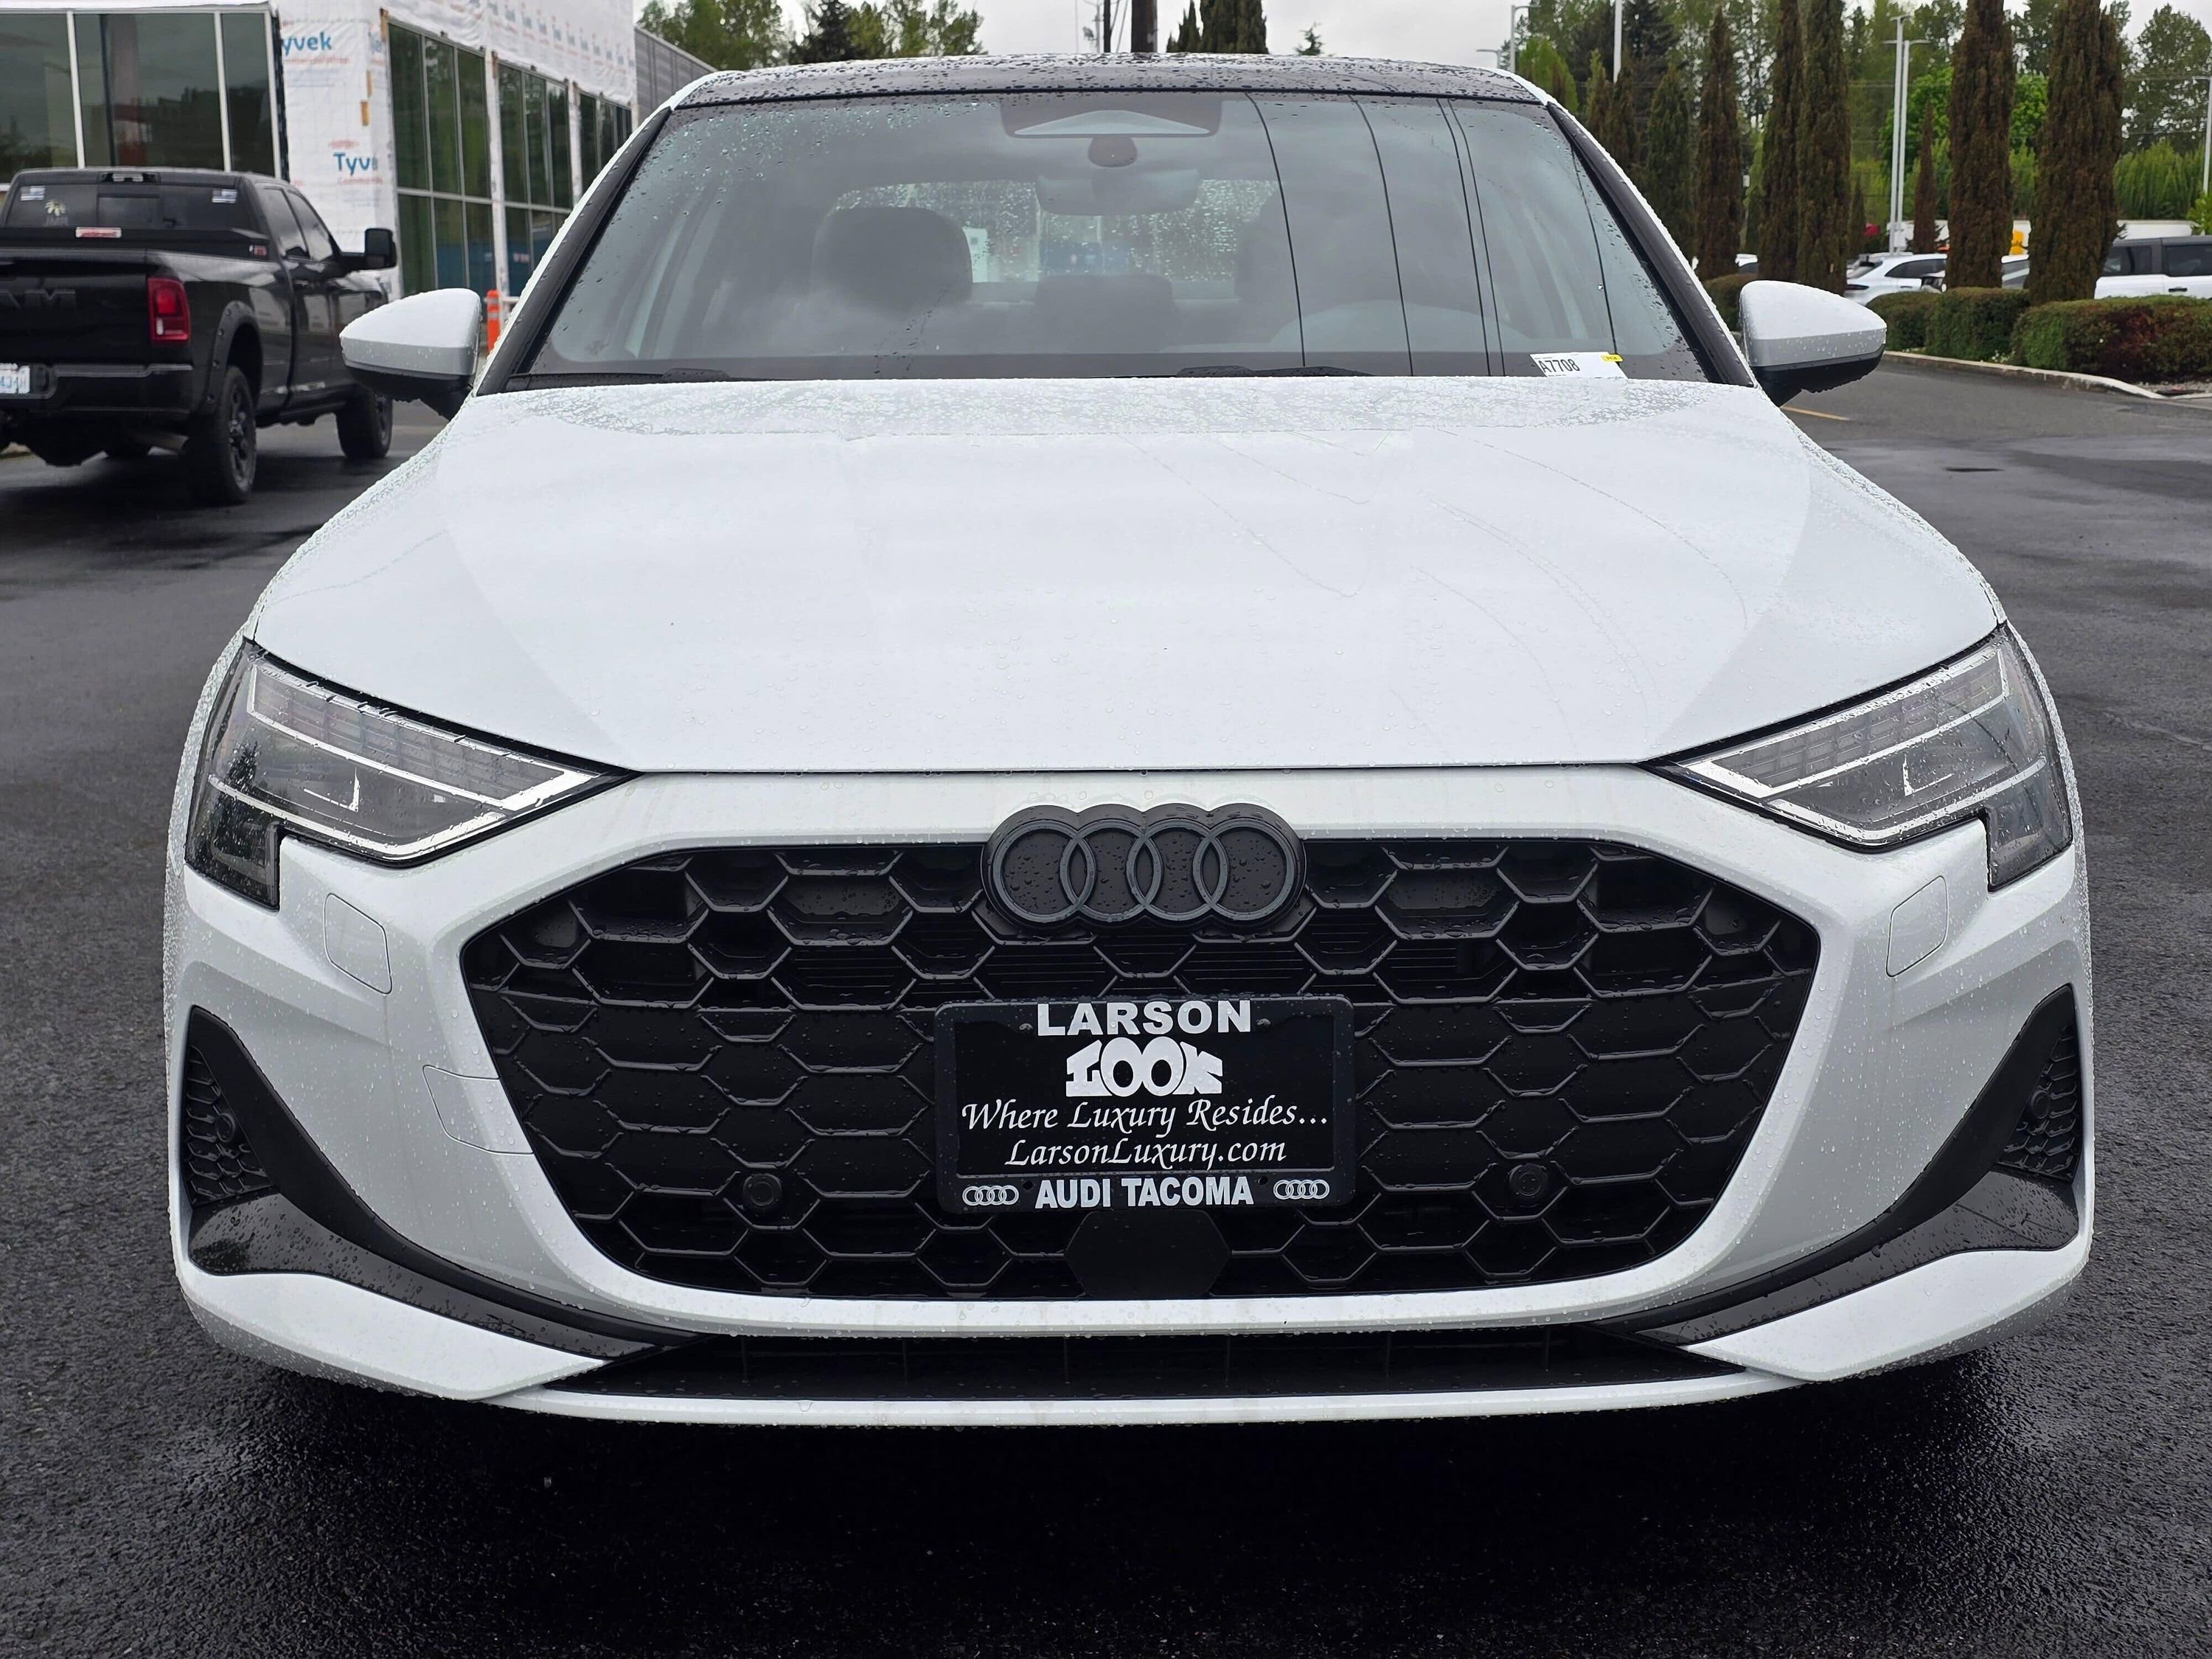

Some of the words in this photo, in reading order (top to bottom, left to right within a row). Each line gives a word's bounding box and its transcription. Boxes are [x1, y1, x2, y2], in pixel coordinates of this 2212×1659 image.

[280, 31, 332, 56] yvek
[1538, 358, 1580, 373] A7708
[1037, 1000, 1251, 1036] LARSON
[962, 1099, 1058, 1130] Where
[1067, 1102, 1176, 1138] Luxury
[1186, 1094, 1327, 1127] Resides...
[1005, 1138, 1287, 1170] LarsonLuxury.com
[1035, 1179, 1110, 1208] AUDI
[1121, 1176, 1253, 1207] TACOMA
